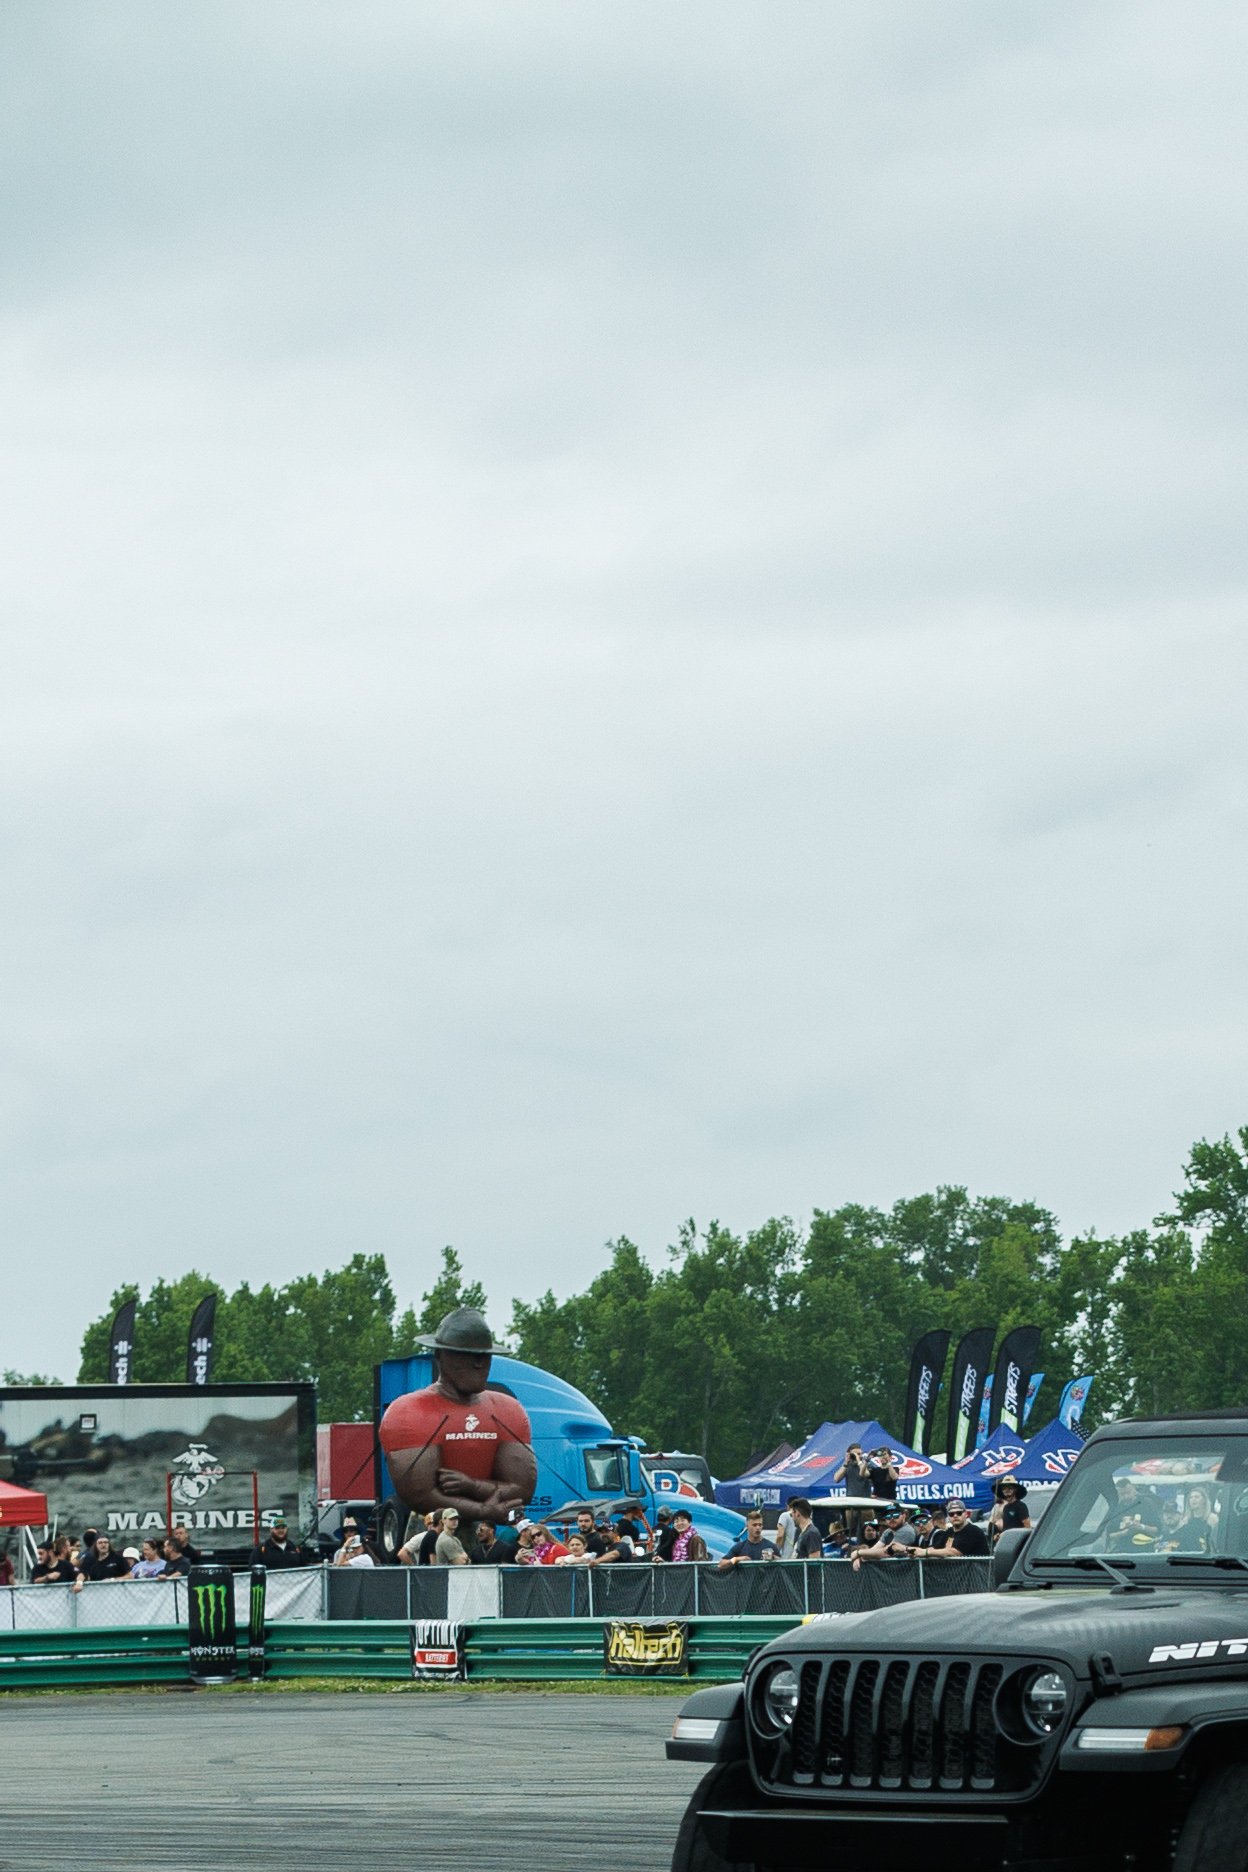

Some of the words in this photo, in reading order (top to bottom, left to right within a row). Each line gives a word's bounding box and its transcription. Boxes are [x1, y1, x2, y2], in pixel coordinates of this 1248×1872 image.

[960, 1362, 977, 1416] STREETS
[1003, 1360, 1021, 1414] STREETS
[445, 1432, 498, 1441] MARINES
[107, 1509, 284, 1531] MARINES
